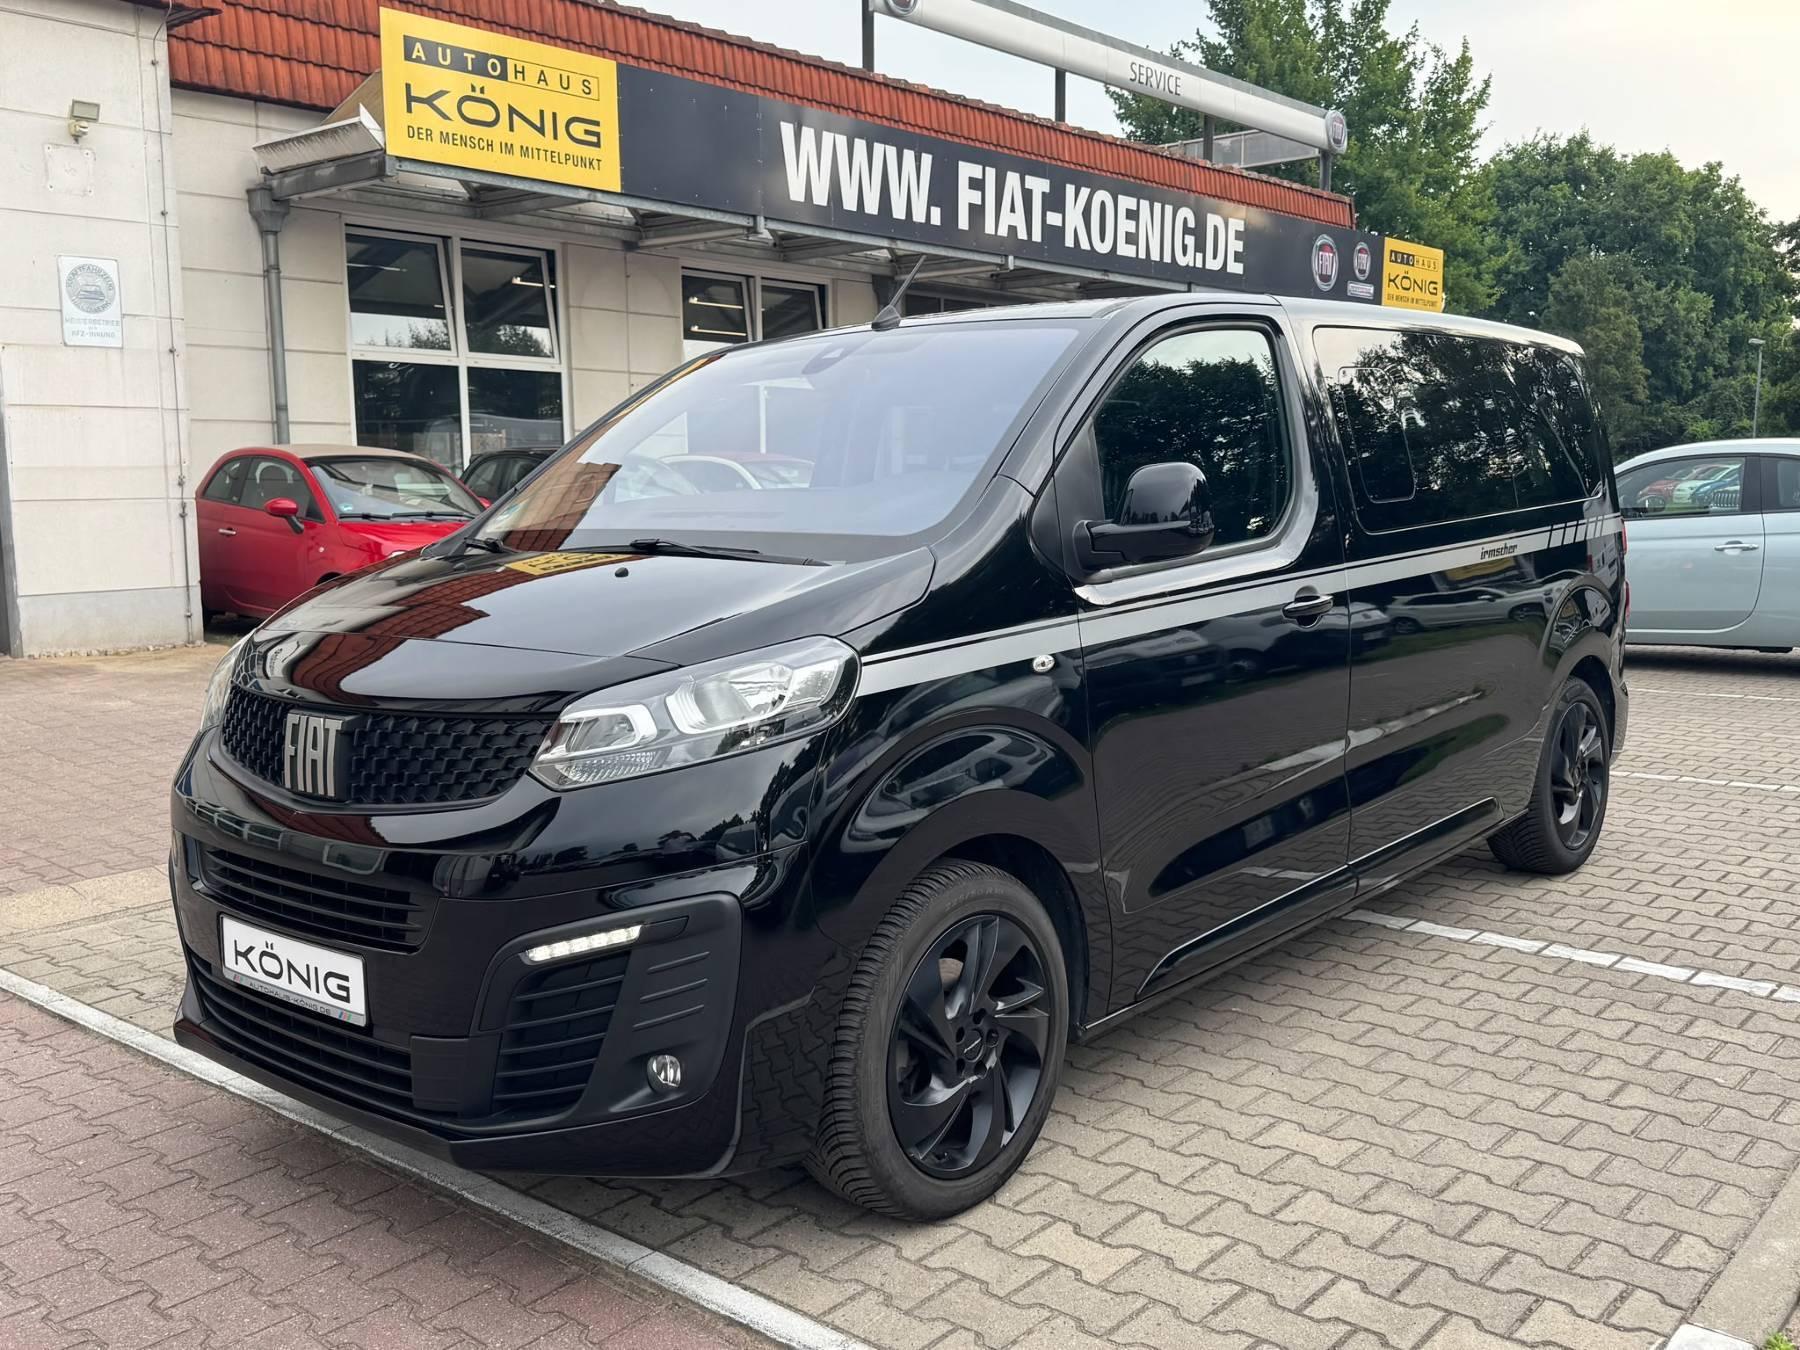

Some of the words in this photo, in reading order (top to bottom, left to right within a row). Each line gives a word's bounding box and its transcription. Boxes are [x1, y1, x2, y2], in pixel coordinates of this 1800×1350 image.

[411, 42, 592, 95] AUTOHAUS
[1129, 61, 1181, 96] SERVICE
[404, 83, 602, 149] KÖNIG
[407, 125, 434, 143] DER
[439, 130, 494, 153] MENSCH
[499, 141, 515, 157] IM
[519, 145, 602, 172] MITTELPUNKT
[779, 121, 942, 226] WWW.
[957, 160, 1246, 275] FIAT-KOENIG.DE
[1387, 270, 1438, 296] KÖNIG
[1391, 251, 1437, 270] AUTOHAUS
[1480, 542, 1518, 560] irmscher
[284, 713, 343, 797] FIAT
[234, 939, 351, 1004] KÖNIG
